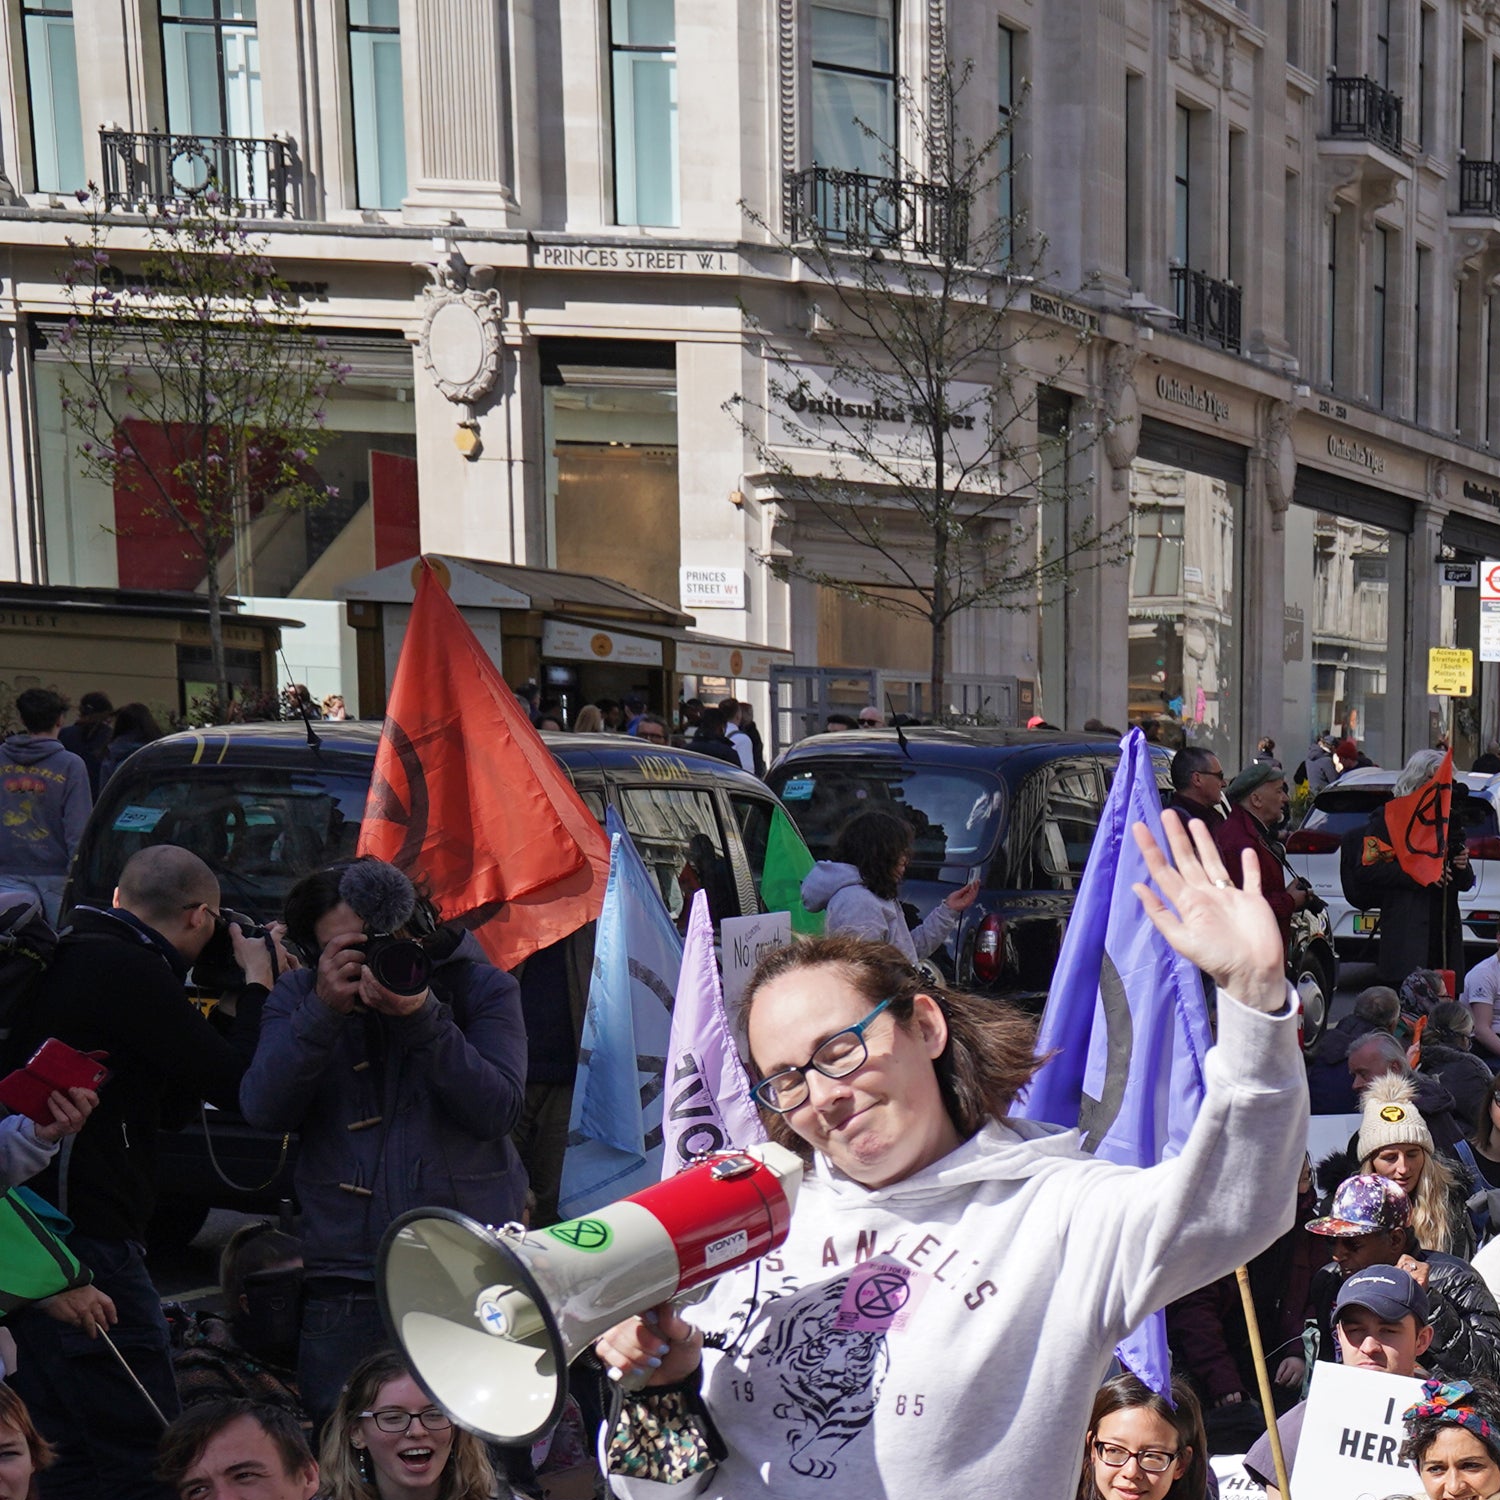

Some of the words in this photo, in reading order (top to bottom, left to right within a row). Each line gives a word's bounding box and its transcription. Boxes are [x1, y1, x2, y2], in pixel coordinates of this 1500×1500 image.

[543, 248, 618, 267] PRINCES
[626, 251, 688, 270] STREET
[787, 390, 906, 423] Onitsuka
[1156, 374, 1206, 410] Onitsuka
[1204, 389, 1231, 422] Tiger
[686, 571, 726, 583] PRINCES
[686, 583, 721, 594] STREET
[724, 585, 739, 595] W1
[1431, 656, 1462, 664] Stratford
[632, 755, 694, 782] VODKA
[733, 937, 750, 970] No
[706, 1231, 746, 1255] VONYX
